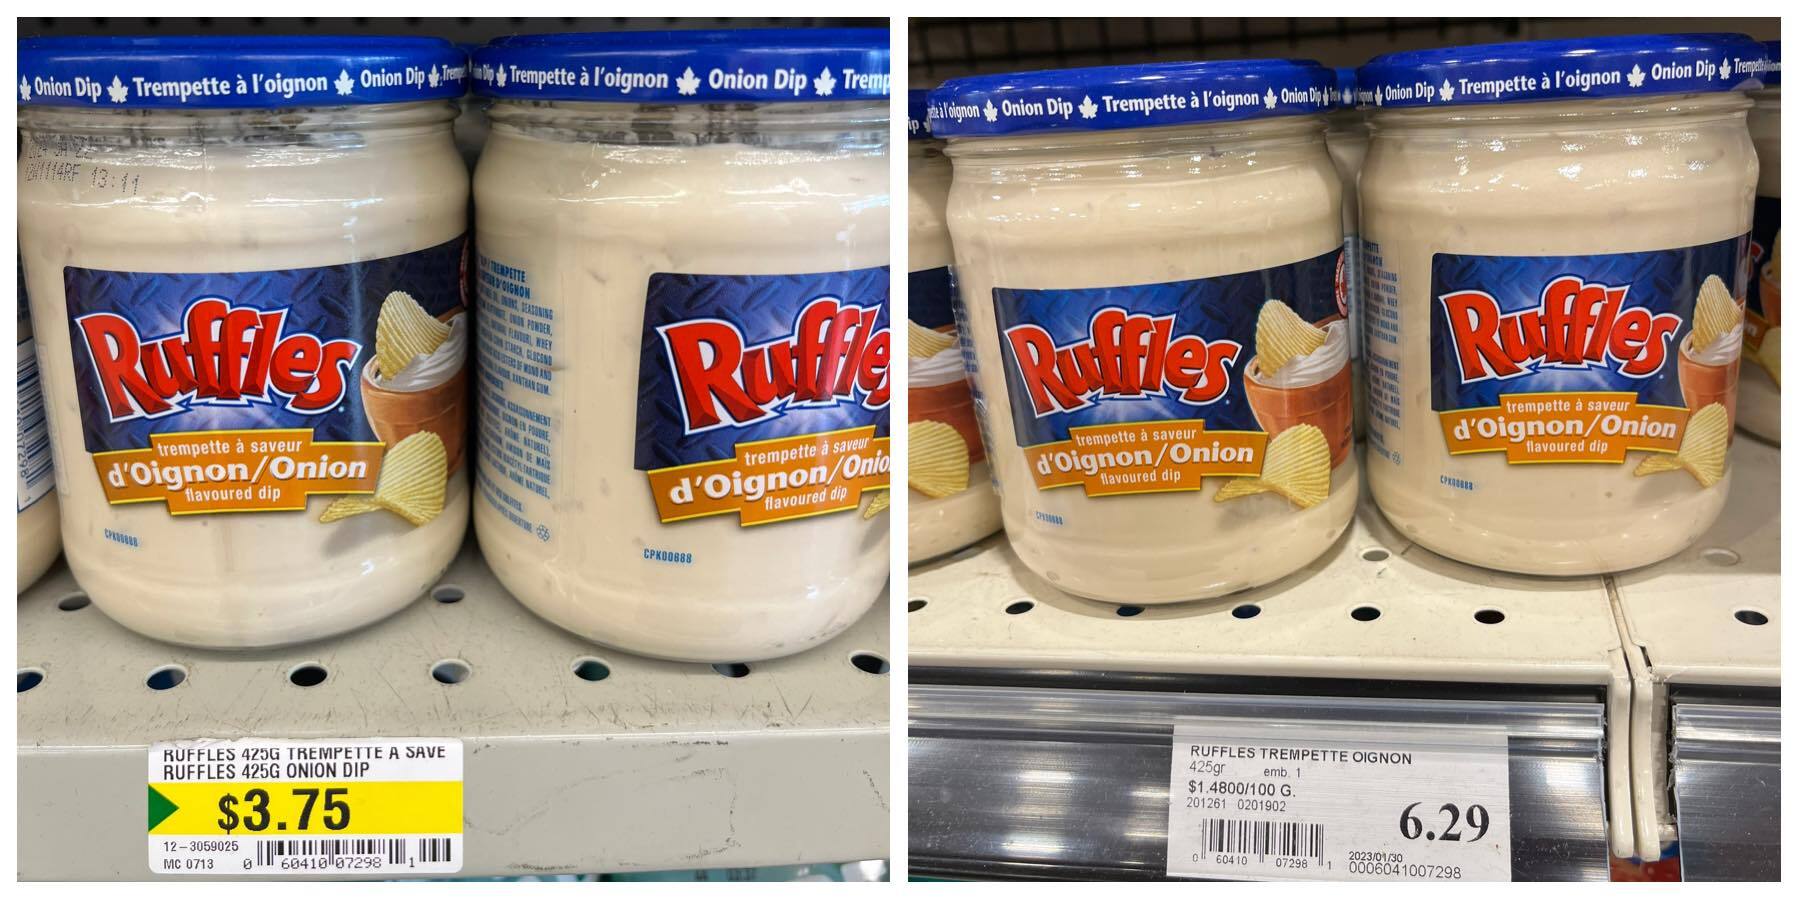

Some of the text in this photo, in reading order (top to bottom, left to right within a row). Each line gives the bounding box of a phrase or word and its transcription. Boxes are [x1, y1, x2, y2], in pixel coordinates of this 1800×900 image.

[34, 76, 72, 98] Onion
[75, 76, 102, 103] Dip
[133, 76, 231, 102] Trempette
[236, 73, 248, 95] à
[253, 73, 328, 100] l'oignon
[360, 67, 402, 89] Onion
[405, 66, 426, 90] Dip
[510, 65, 577, 90] Trempette
[579, 66, 589, 86] à
[594, 66, 669, 94] l'oignon
[708, 67, 768, 90] Onion
[774, 67, 808, 97] Dip
[1385, 84, 1413, 101] Onion
[1415, 81, 1435, 103] Dip
[1459, 75, 1537, 98] Trempette
[1541, 72, 1551, 90] à
[1555, 69, 1621, 92] l'oignon
[1651, 61, 1692, 81] Onion
[1695, 60, 1716, 82] Dip
[944, 101, 980, 124] l'oignon
[1001, 98, 1043, 118] Onion
[1046, 97, 1073, 120] Dip
[1101, 95, 1186, 117] Trempette
[1191, 91, 1200, 109] à
[1203, 90, 1260, 112] l'oignon
[1281, 87, 1308, 105] Onion
[1309, 86, 1322, 108] Dip
[1439, 276, 1683, 384] Ruffles
[76, 298, 362, 422] Ruffles
[1004, 307, 1242, 419] Ruffles
[1506, 397, 1631, 416] trempette à saveur
[1075, 427, 1198, 448] trempette à saveur
[1525, 439, 1609, 454] flavoured dip
[157, 437, 304, 460] trempette à saveur
[744, 436, 871, 467] trempette à saveur
[1100, 469, 1182, 487] flavoured dip
[185, 486, 282, 504] flavoured dip
[764, 486, 848, 511] flavoured dip
[163, 746, 447, 762] RUFFLES 425G TREMPETTE A SAVE
[1190, 745, 1413, 765] RUFFLES TREMPETTE OIGNON
[163, 762, 370, 781] RUFFLES 425G ONION DIP
[1189, 760, 1302, 778] 425gr emb. 1
[1188, 780, 1297, 798] $1.4800/100 G.
[217, 788, 351, 835] $3.75
[1186, 797, 1287, 812] 201261 0201902
[1399, 801, 1490, 843] 6.29
[163, 858, 214, 870] MC 0713
[280, 857, 328, 870] 60410
[335, 857, 382, 869] 07298
[408, 857, 415, 868] 1
[1192, 853, 1332, 870] 0 60410 07298 1
[1349, 851, 1403, 864] 2023/01/30
[1348, 861, 1462, 880] 0006041007298
